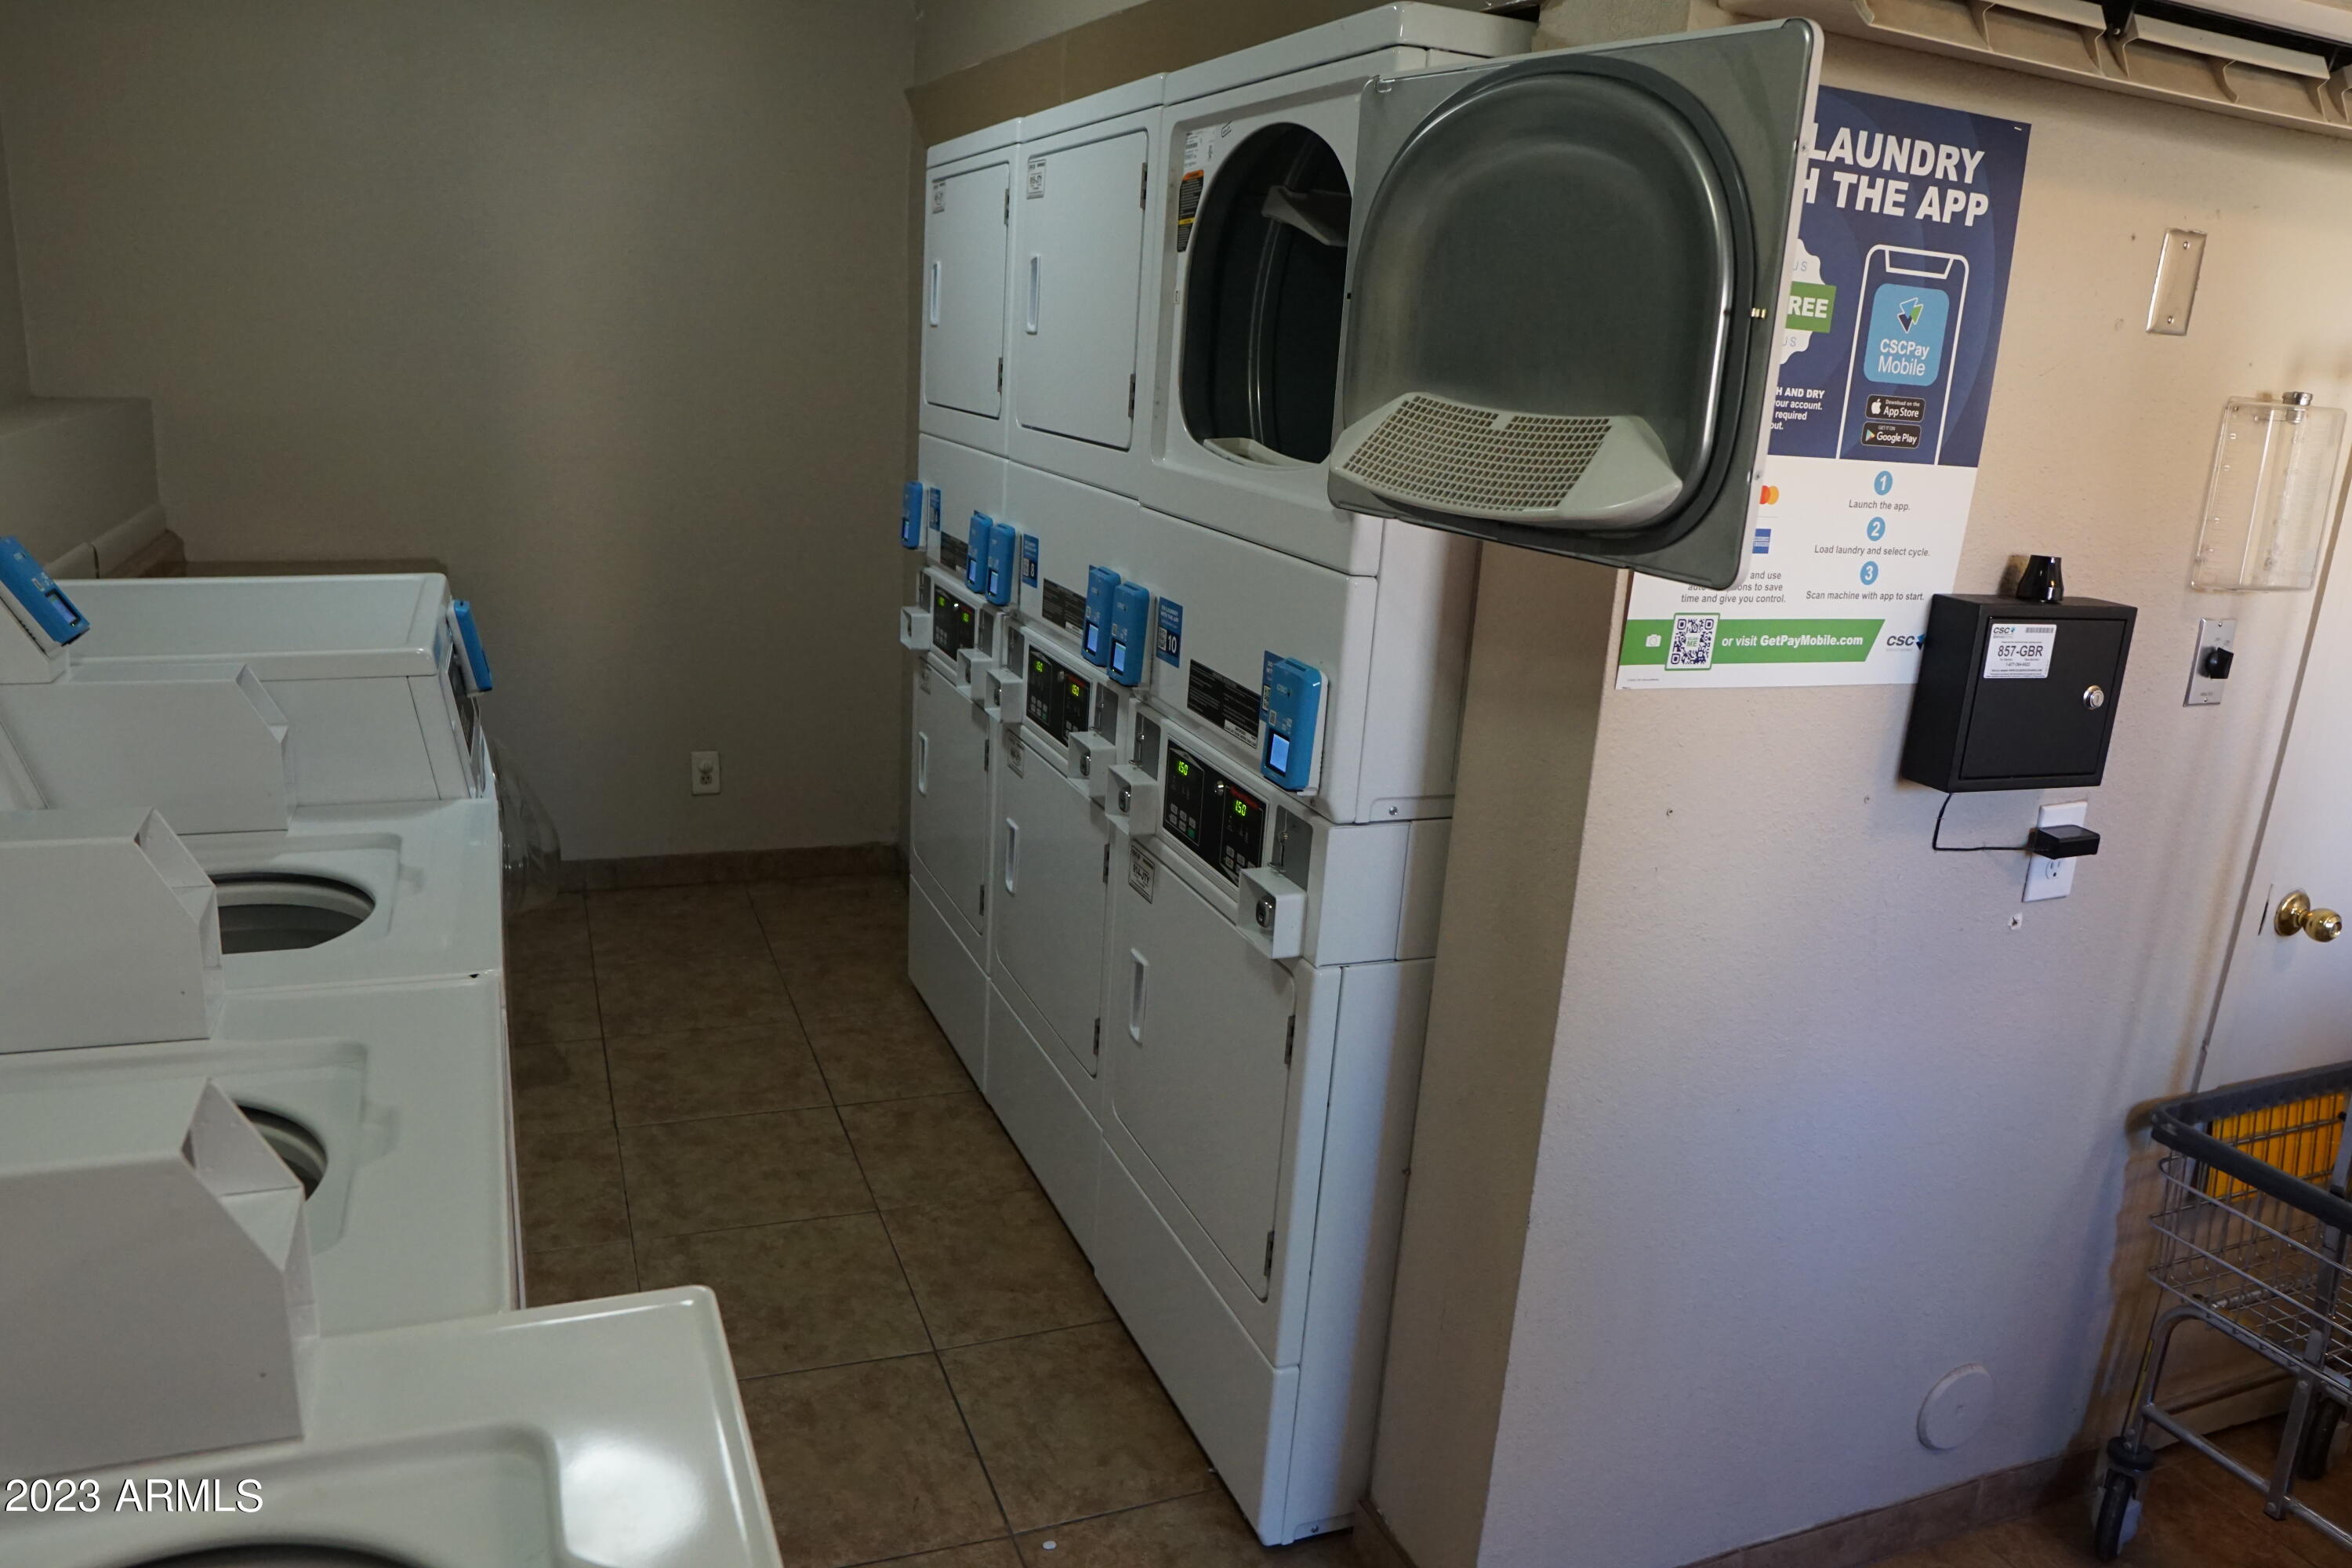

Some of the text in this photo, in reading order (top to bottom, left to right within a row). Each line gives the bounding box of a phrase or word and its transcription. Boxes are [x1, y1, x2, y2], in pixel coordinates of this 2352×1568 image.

[1809, 122, 1985, 184] LAUNDRY
[1833, 171, 1910, 217] THE
[1915, 186, 1990, 227] APP
[1879, 338, 1930, 361] CSCPay
[1878, 354, 1926, 376] Mobile
[1784, 387, 1804, 397] AND
[1806, 389, 1825, 399] DRY
[1790, 401, 1823, 410] account.
[1883, 405, 1919, 418] App Store
[1775, 410, 1808, 421] required
[1876, 431, 1918, 445] Google Play
[1879, 475, 1887, 491] 1
[1849, 499, 1911, 513] Launch the app.
[1871, 521, 1881, 537] 2
[1814, 544, 1930, 558] Load laundry and select cycle.
[1750, 571, 1765, 579] and
[1864, 564, 1874, 581] 3
[1681, 593, 1786, 605] time and give you control.
[1806, 590, 1925, 602] Scan machine with app to start.
[1168, 634, 1177, 654] 10
[1721, 634, 1864, 648] or visit GetPayMobile.com
[1886, 635, 1915, 646] CSC
[1998, 645, 2044, 657] 857-GBR
